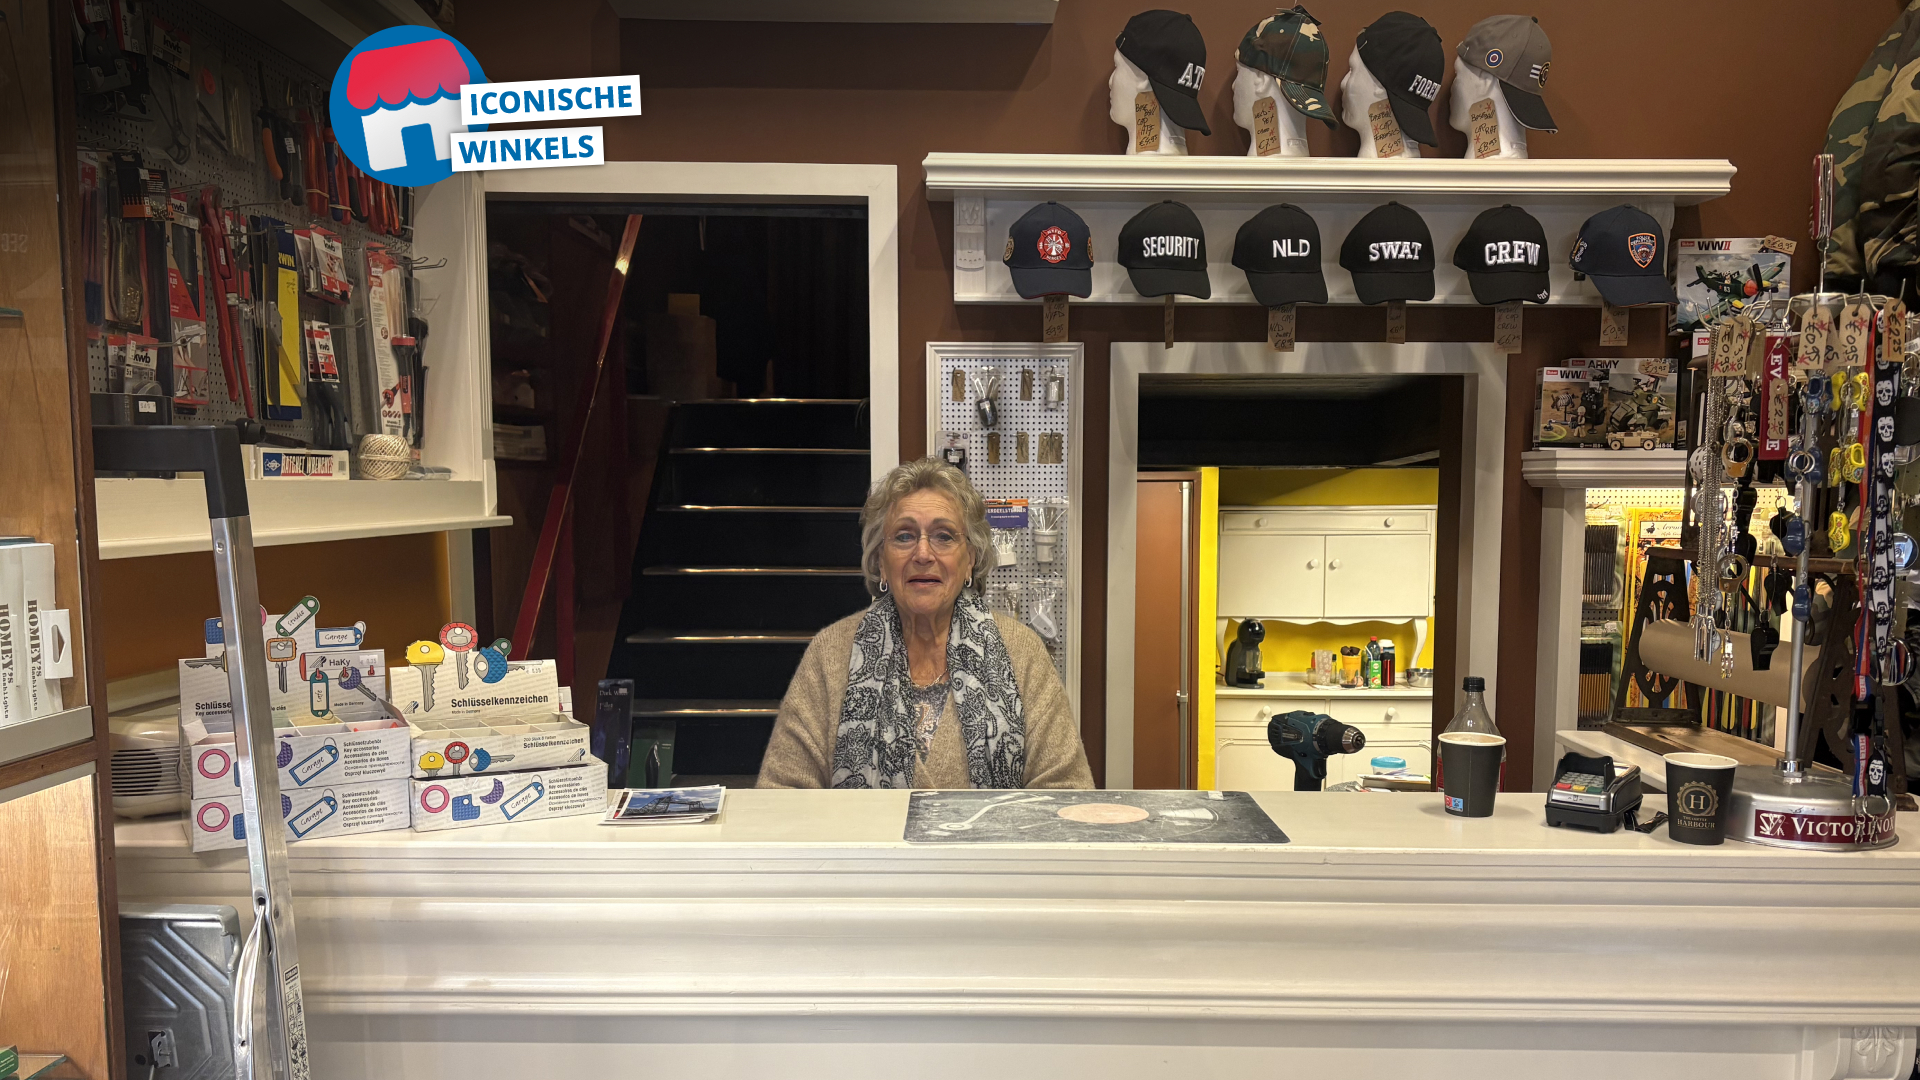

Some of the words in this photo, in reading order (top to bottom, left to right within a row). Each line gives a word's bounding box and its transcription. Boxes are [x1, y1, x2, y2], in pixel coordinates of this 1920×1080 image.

[1142, 235, 1200, 259] SECURITY
[1272, 238, 1311, 258] NLD
[1369, 241, 1422, 261] SWAT
[1484, 240, 1541, 266] CREW
[1588, 360, 1620, 369] ARMY
[324, 633, 348, 642] Garage
[329, 658, 351, 668] HaKy
[451, 694, 549, 708] Schlüsselkennzeichen
[523, 738, 584, 749] Schlüsselkennzeichen
[301, 757, 325, 774] Garage
[510, 793, 532, 809] Garage
[1689, 794, 1705, 810] H
[300, 808, 324, 826] Garage
[1677, 819, 1715, 829] HARBOUR
